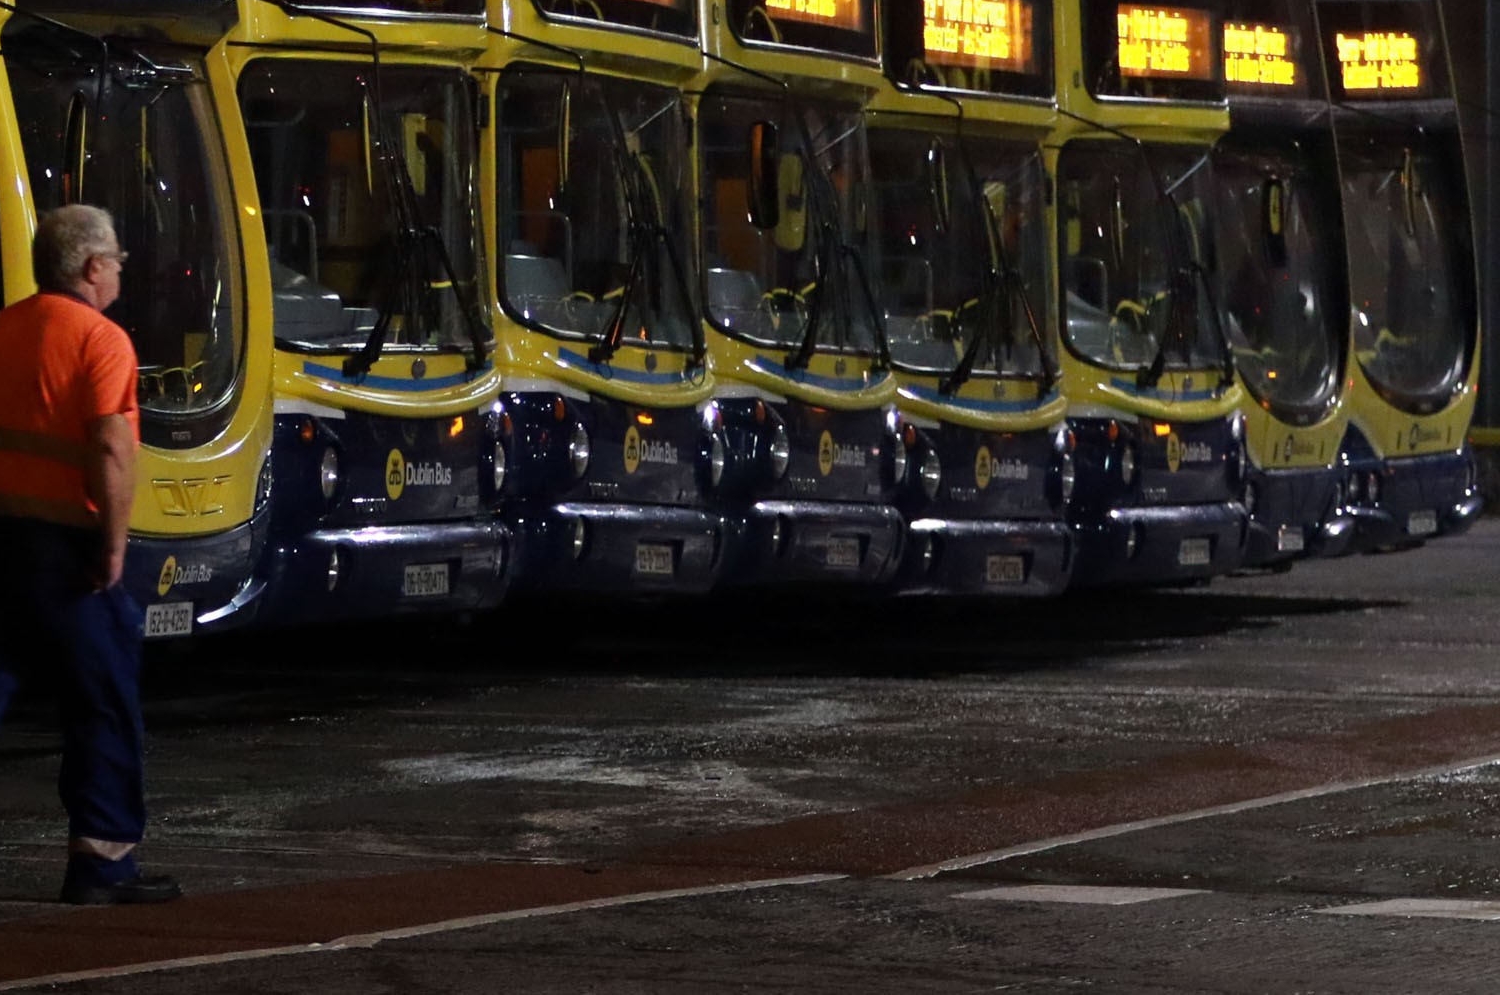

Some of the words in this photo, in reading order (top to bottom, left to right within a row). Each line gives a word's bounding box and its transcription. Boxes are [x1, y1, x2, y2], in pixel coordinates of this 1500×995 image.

[641, 439, 665, 463] Dublin
[665, 441, 678, 465] Bus
[405, 462, 435, 486] Dublin
[435, 462, 452, 486] Bus
[174, 565, 198, 585] Dublin
[197, 564, 213, 583] Bus
